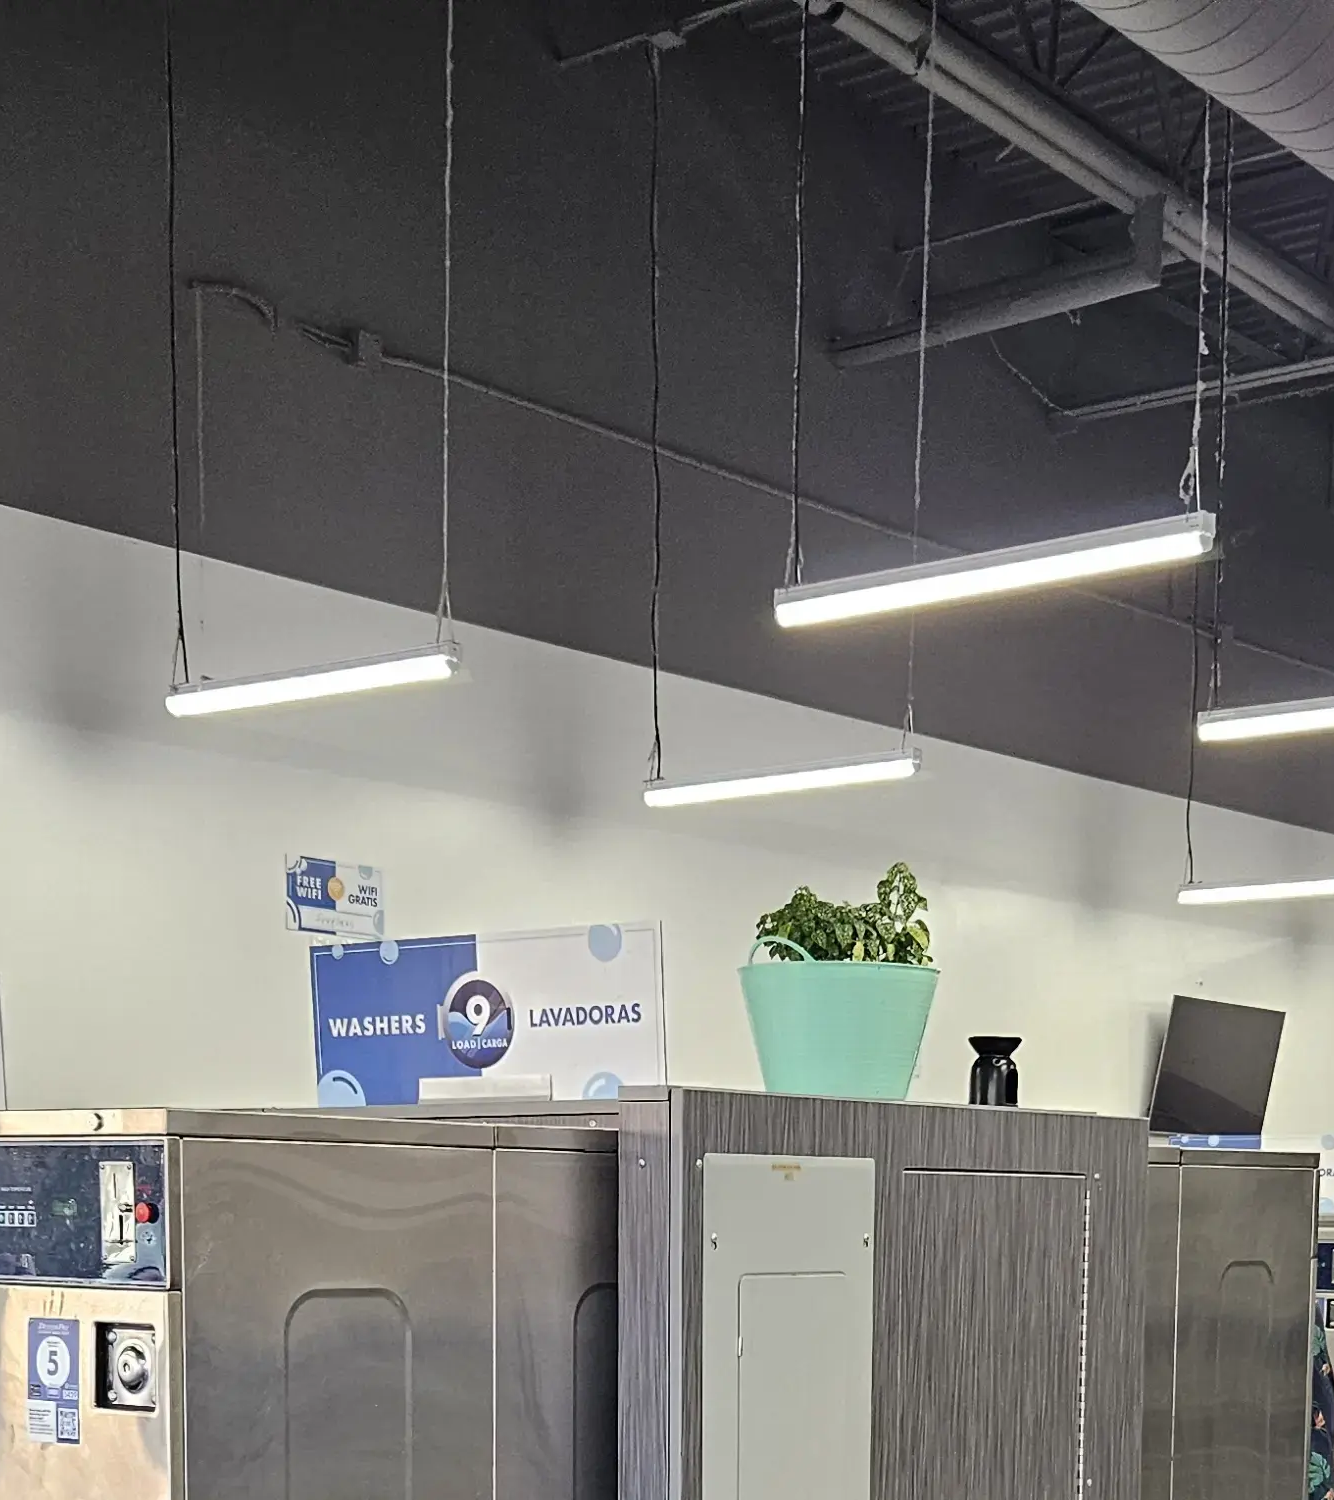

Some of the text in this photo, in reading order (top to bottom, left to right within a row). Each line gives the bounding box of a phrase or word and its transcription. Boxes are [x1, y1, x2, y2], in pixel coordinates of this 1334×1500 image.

[296, 875, 322, 889] FREE
[295, 886, 322, 900] WIFI
[357, 884, 378, 897] WIFI
[347, 894, 378, 908] GRATIS
[328, 994, 642, 1038] WASHERS 9 LAVADORAS
[451, 1037, 508, 1050] LOAD CARGA
[46, 1350, 59, 1376] 5
